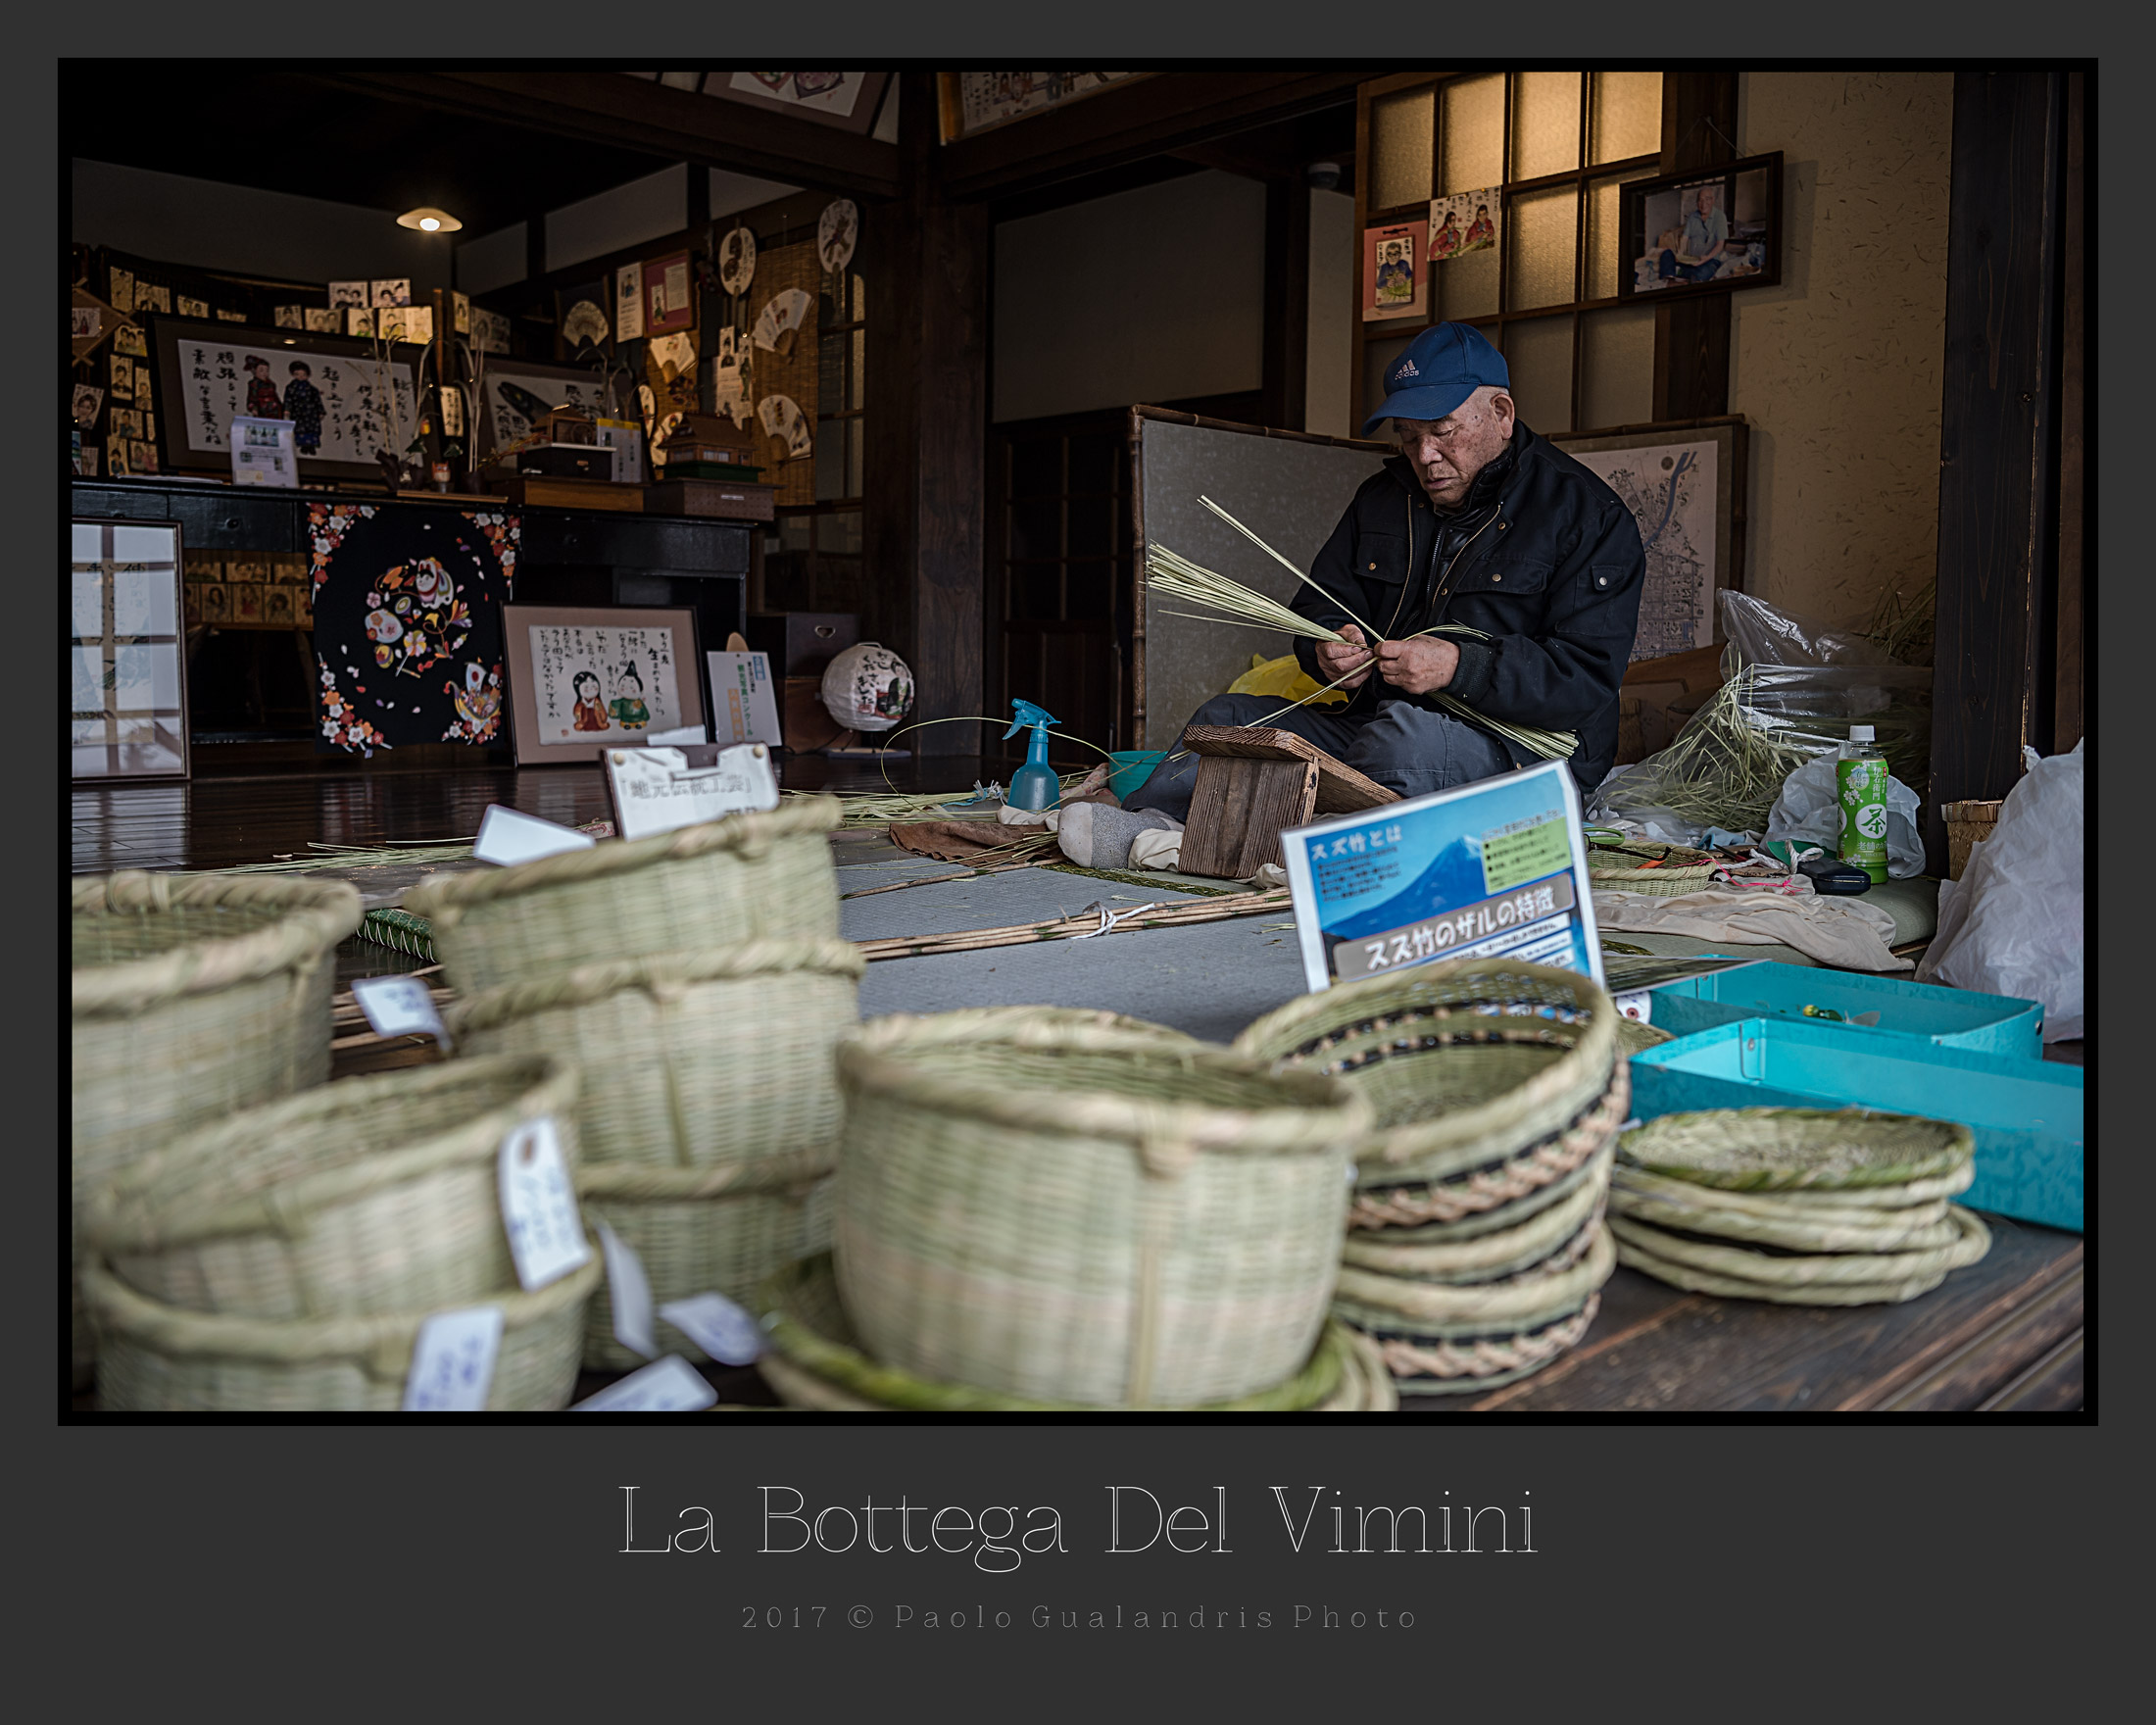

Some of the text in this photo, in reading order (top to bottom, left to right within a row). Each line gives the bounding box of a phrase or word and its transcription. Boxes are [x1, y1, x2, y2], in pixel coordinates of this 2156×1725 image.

[1861, 809, 1886, 834] 茶
[1311, 823, 1403, 861] スズ竹とは
[1364, 886, 1555, 970] スズ竹のザルの特徴
